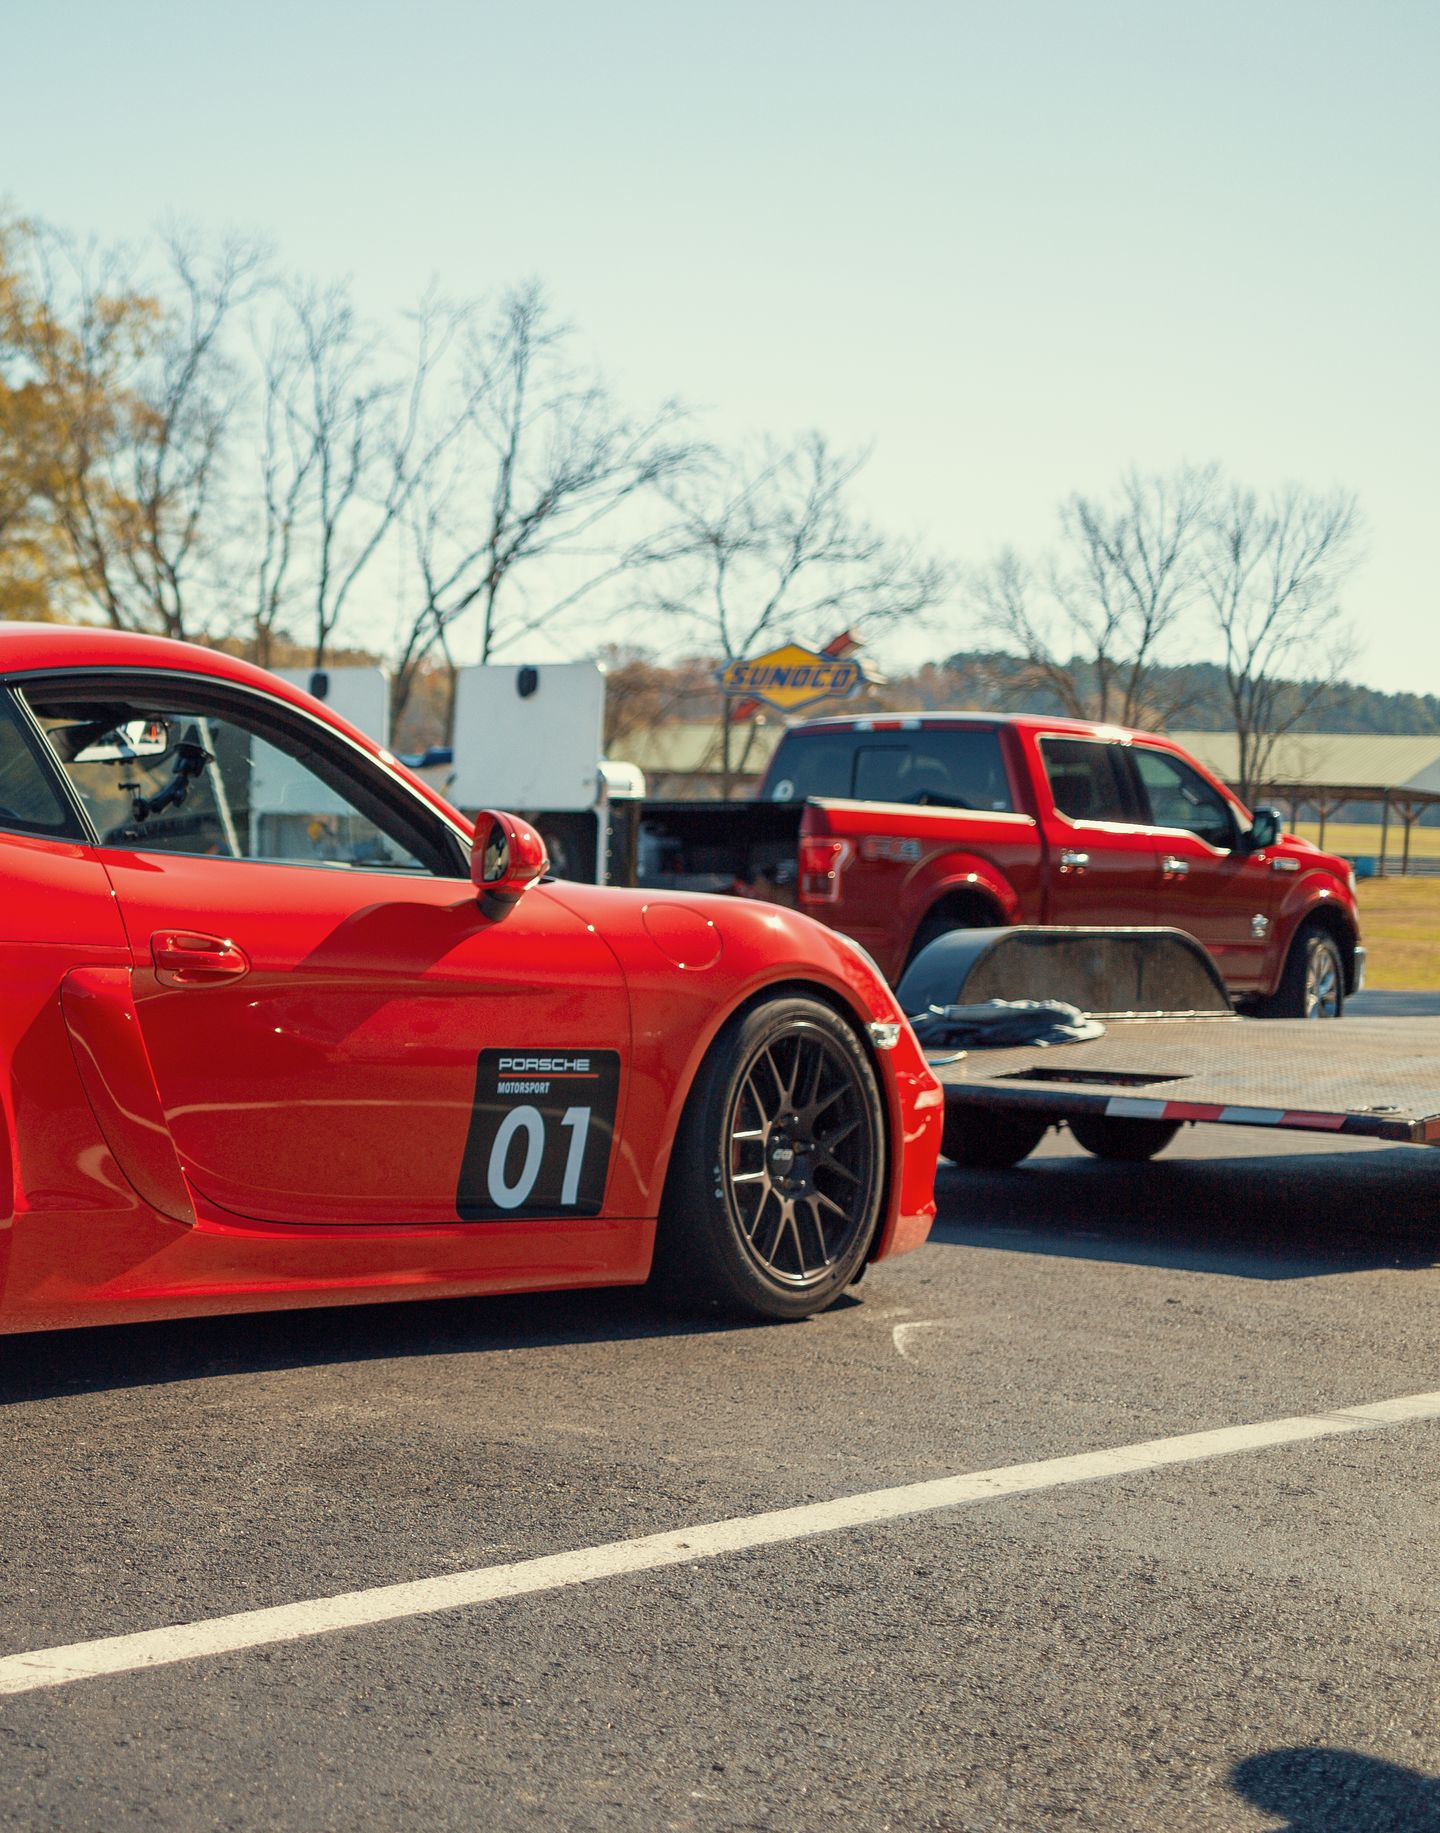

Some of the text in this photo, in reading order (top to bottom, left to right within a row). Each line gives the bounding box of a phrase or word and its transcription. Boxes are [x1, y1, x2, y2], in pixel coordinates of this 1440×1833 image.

[729, 664, 853, 689] SUNOCO
[498, 1058, 590, 1071] PORSCHE
[497, 1082, 550, 1094] MOTORSPORT
[487, 1104, 591, 1209] 01
